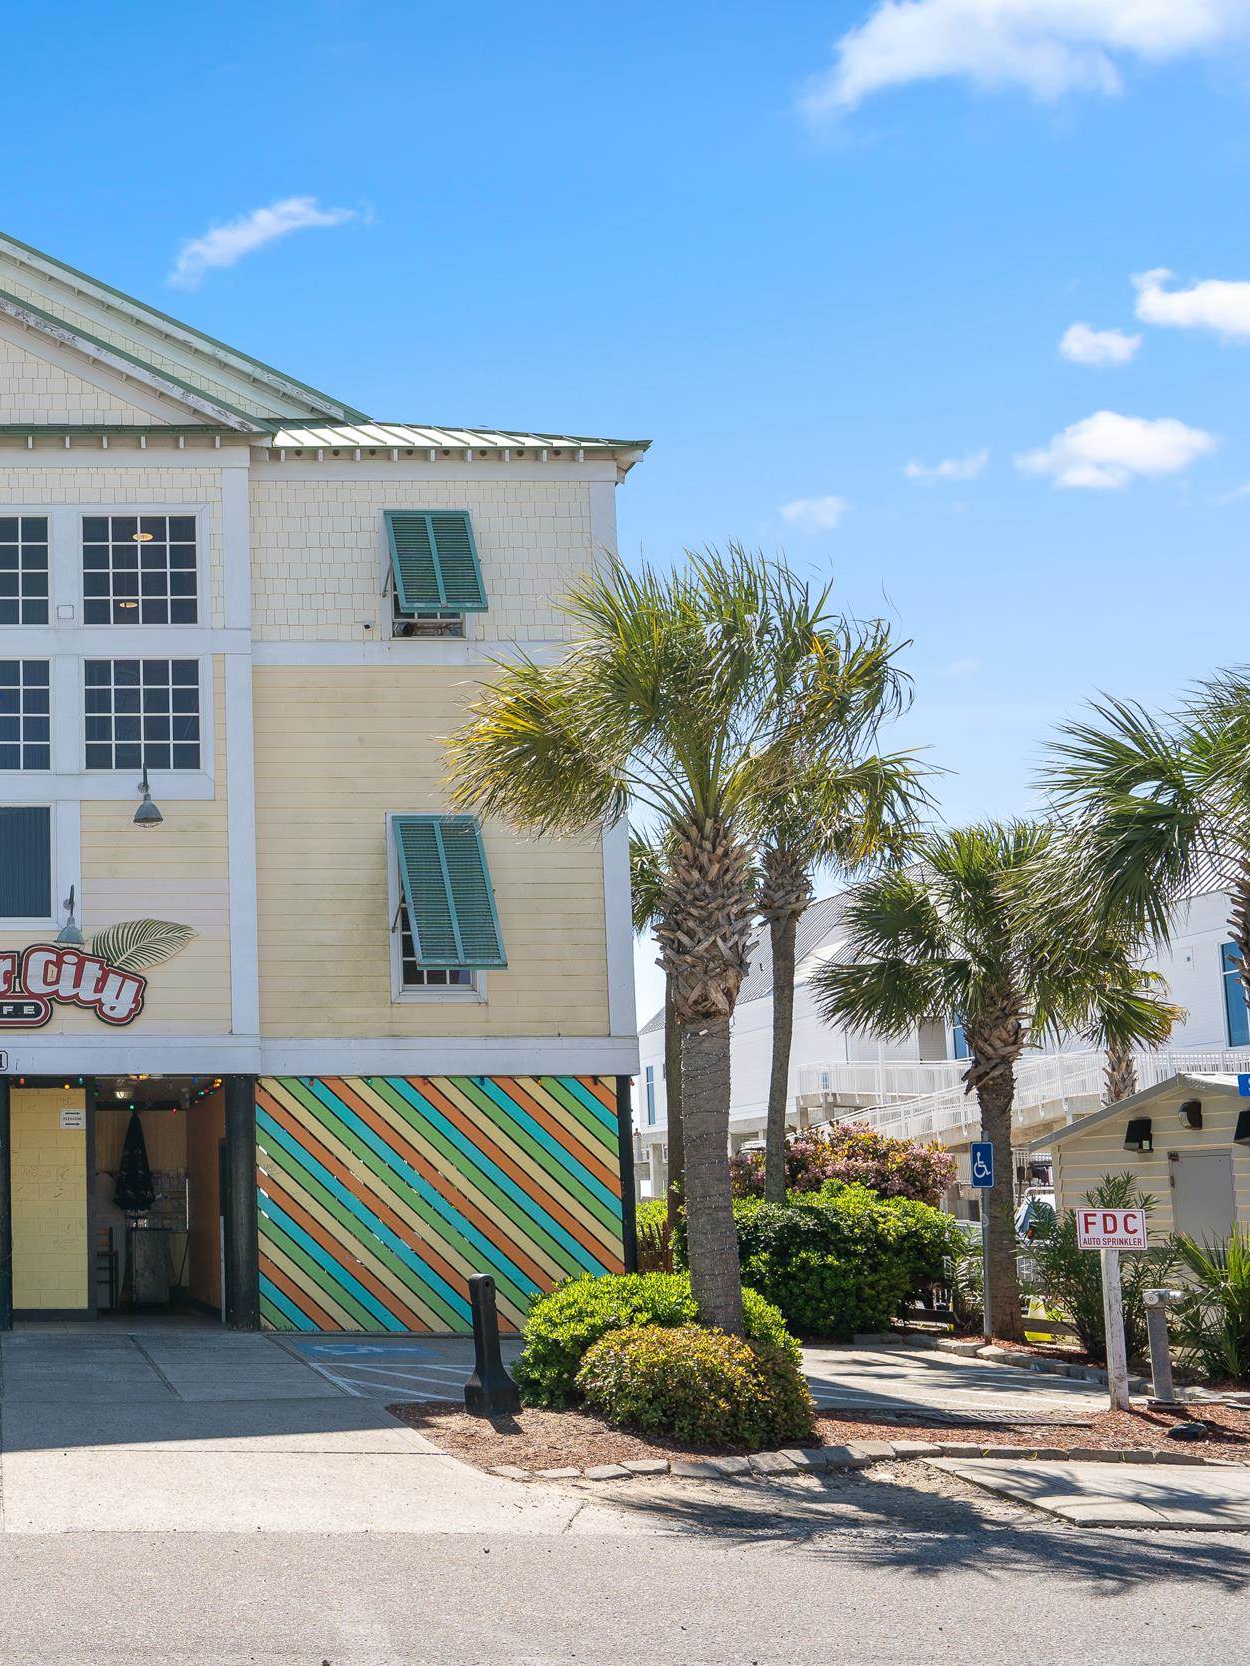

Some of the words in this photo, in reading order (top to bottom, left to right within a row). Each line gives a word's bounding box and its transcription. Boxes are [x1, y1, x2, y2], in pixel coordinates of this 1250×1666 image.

[27, 950, 140, 1017] City
[1083, 1213, 1138, 1234] FDC
[1083, 1237, 1101, 1246] AUTO
[1102, 1237, 1142, 1246] SPRINKLER
